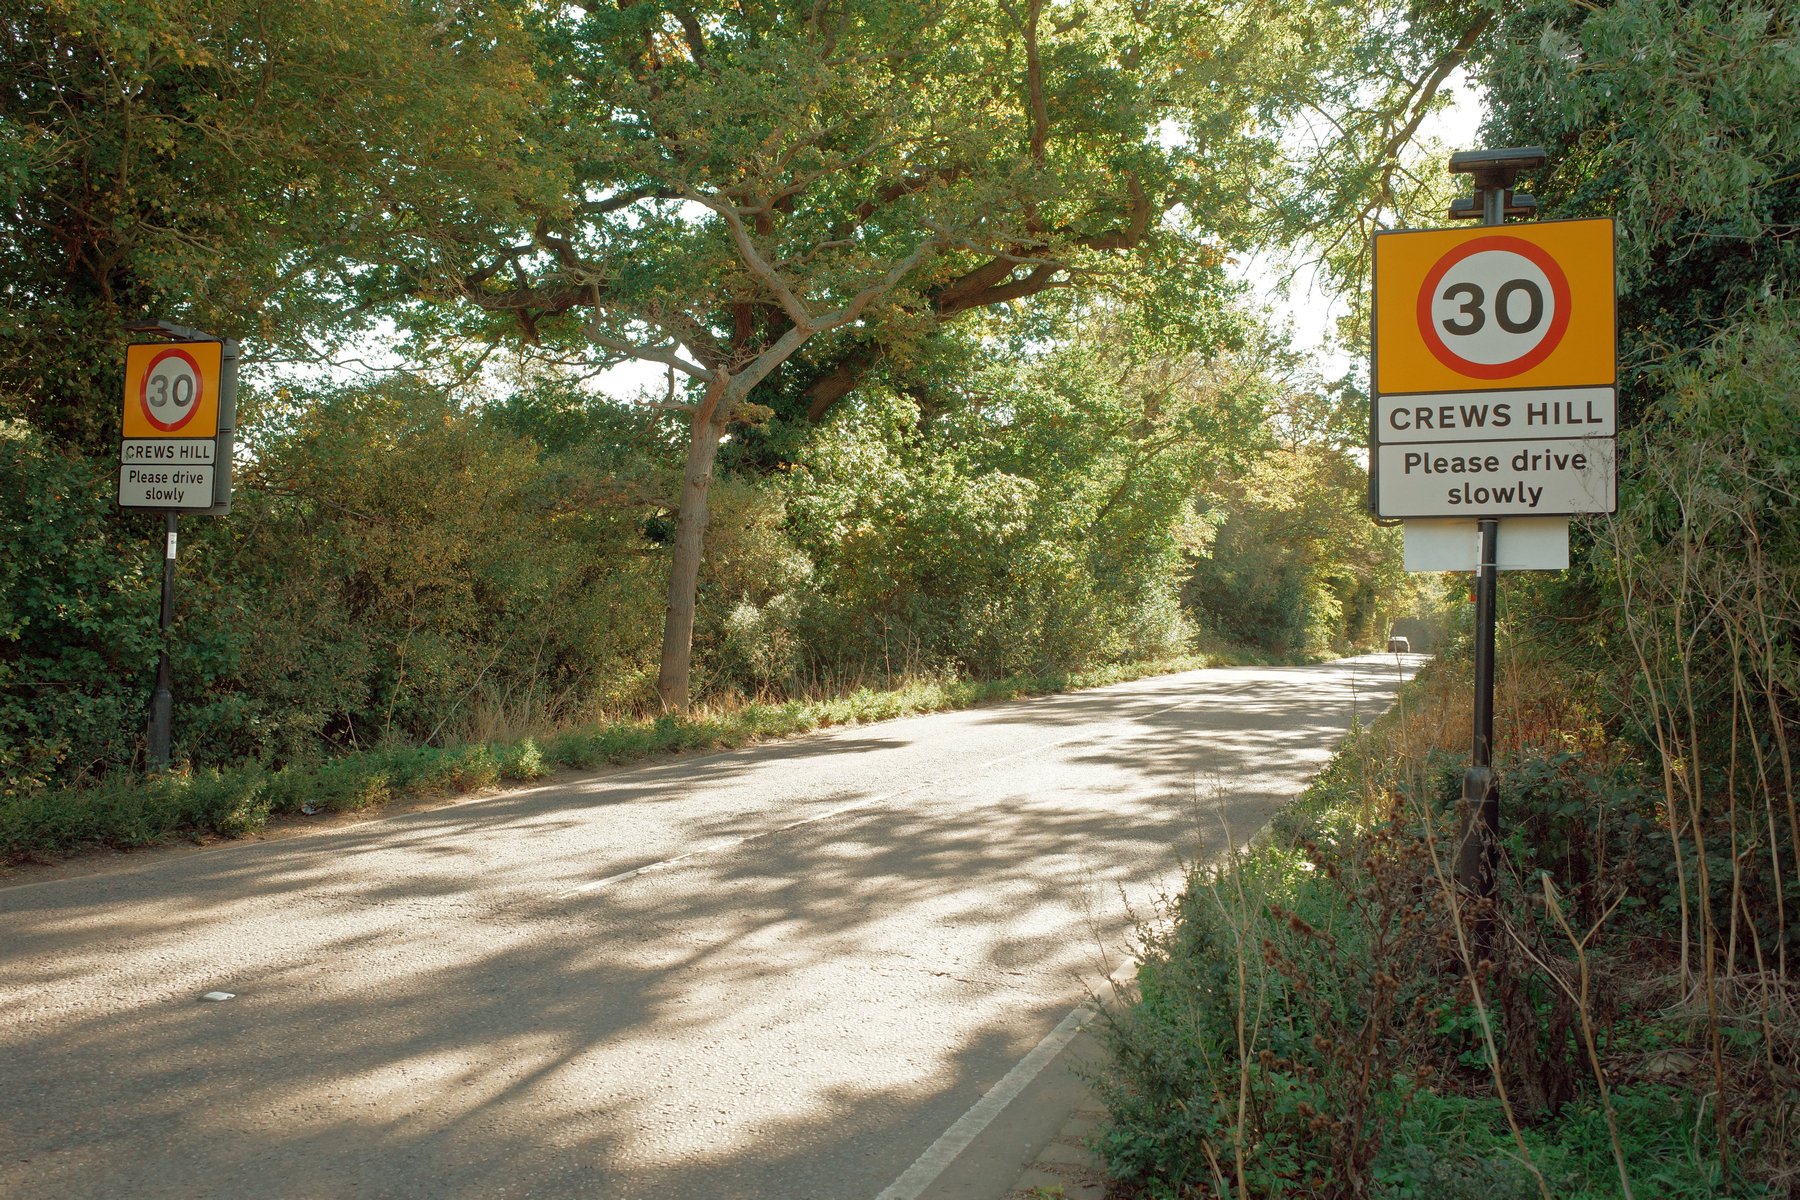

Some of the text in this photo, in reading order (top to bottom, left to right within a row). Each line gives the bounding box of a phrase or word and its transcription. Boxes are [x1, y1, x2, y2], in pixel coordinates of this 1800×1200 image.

[1442, 279, 1544, 336] 30
[149, 374, 194, 407] 30
[1389, 401, 1603, 431] CREWS HILL
[126, 445, 210, 459] CREWS HILL
[1404, 449, 1587, 474] Please drive
[129, 470, 204, 484] Please drive
[145, 487, 185, 502] slowly
[1447, 481, 1543, 507] slowly
